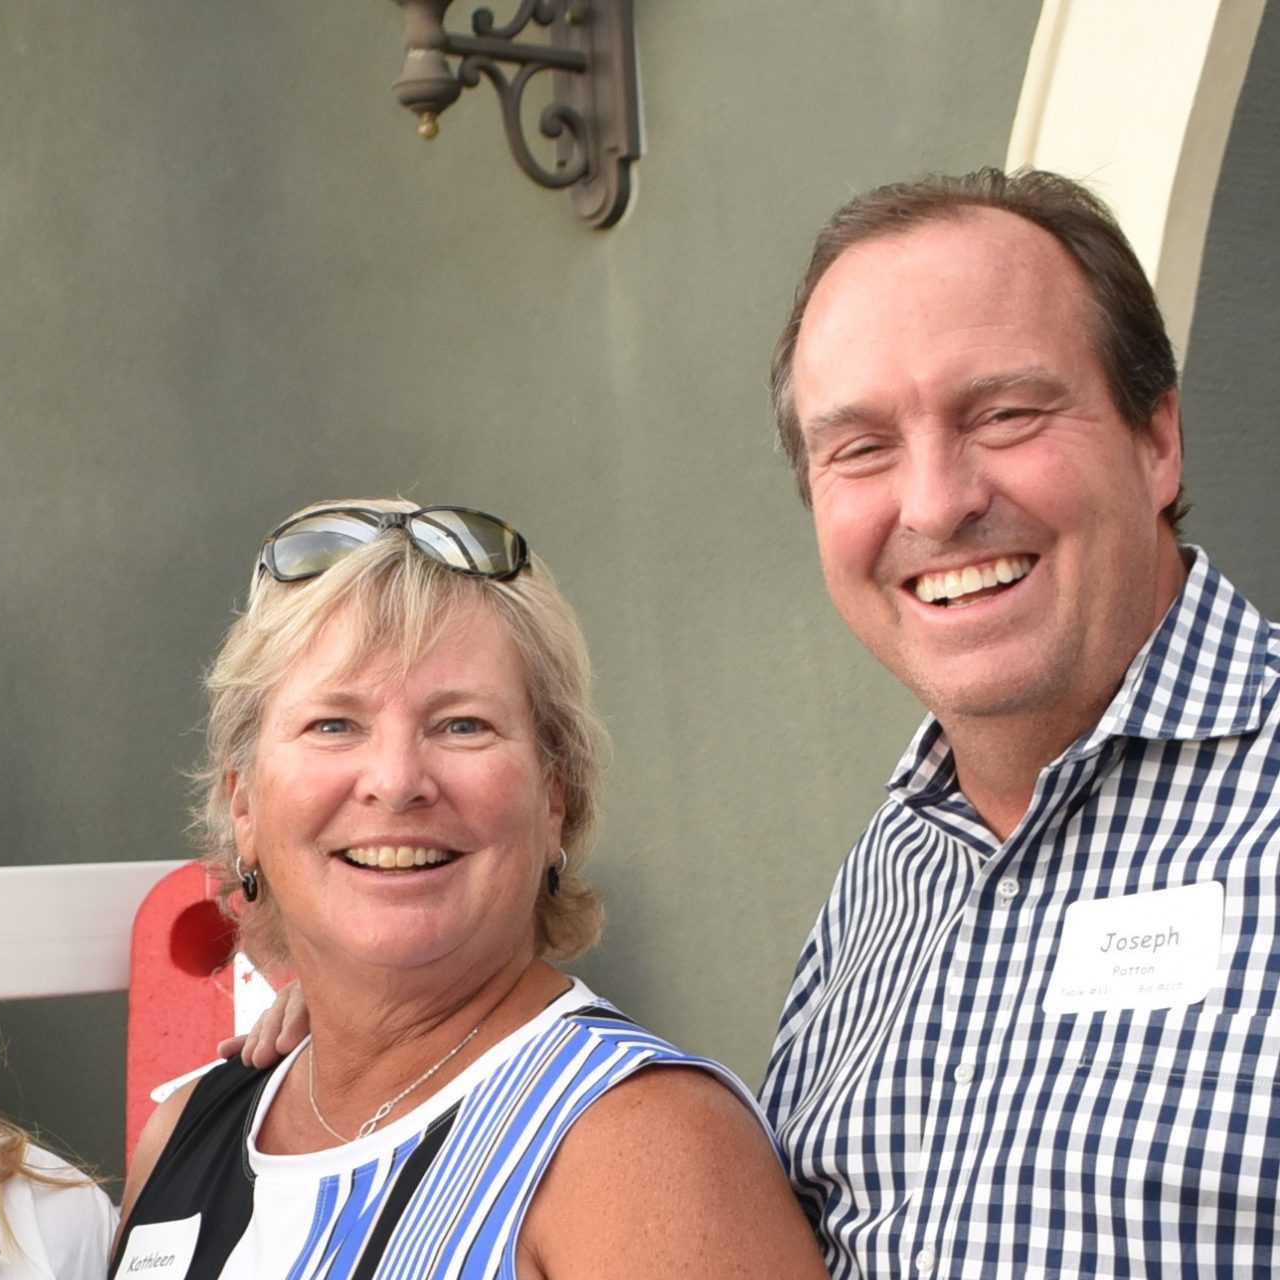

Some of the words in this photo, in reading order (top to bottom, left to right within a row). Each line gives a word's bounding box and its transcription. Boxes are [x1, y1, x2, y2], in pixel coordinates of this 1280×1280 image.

[1100, 926, 1180, 953] Joseph
[1112, 965, 1154, 976] Patton
[127, 1252, 175, 1273] Kathleen
